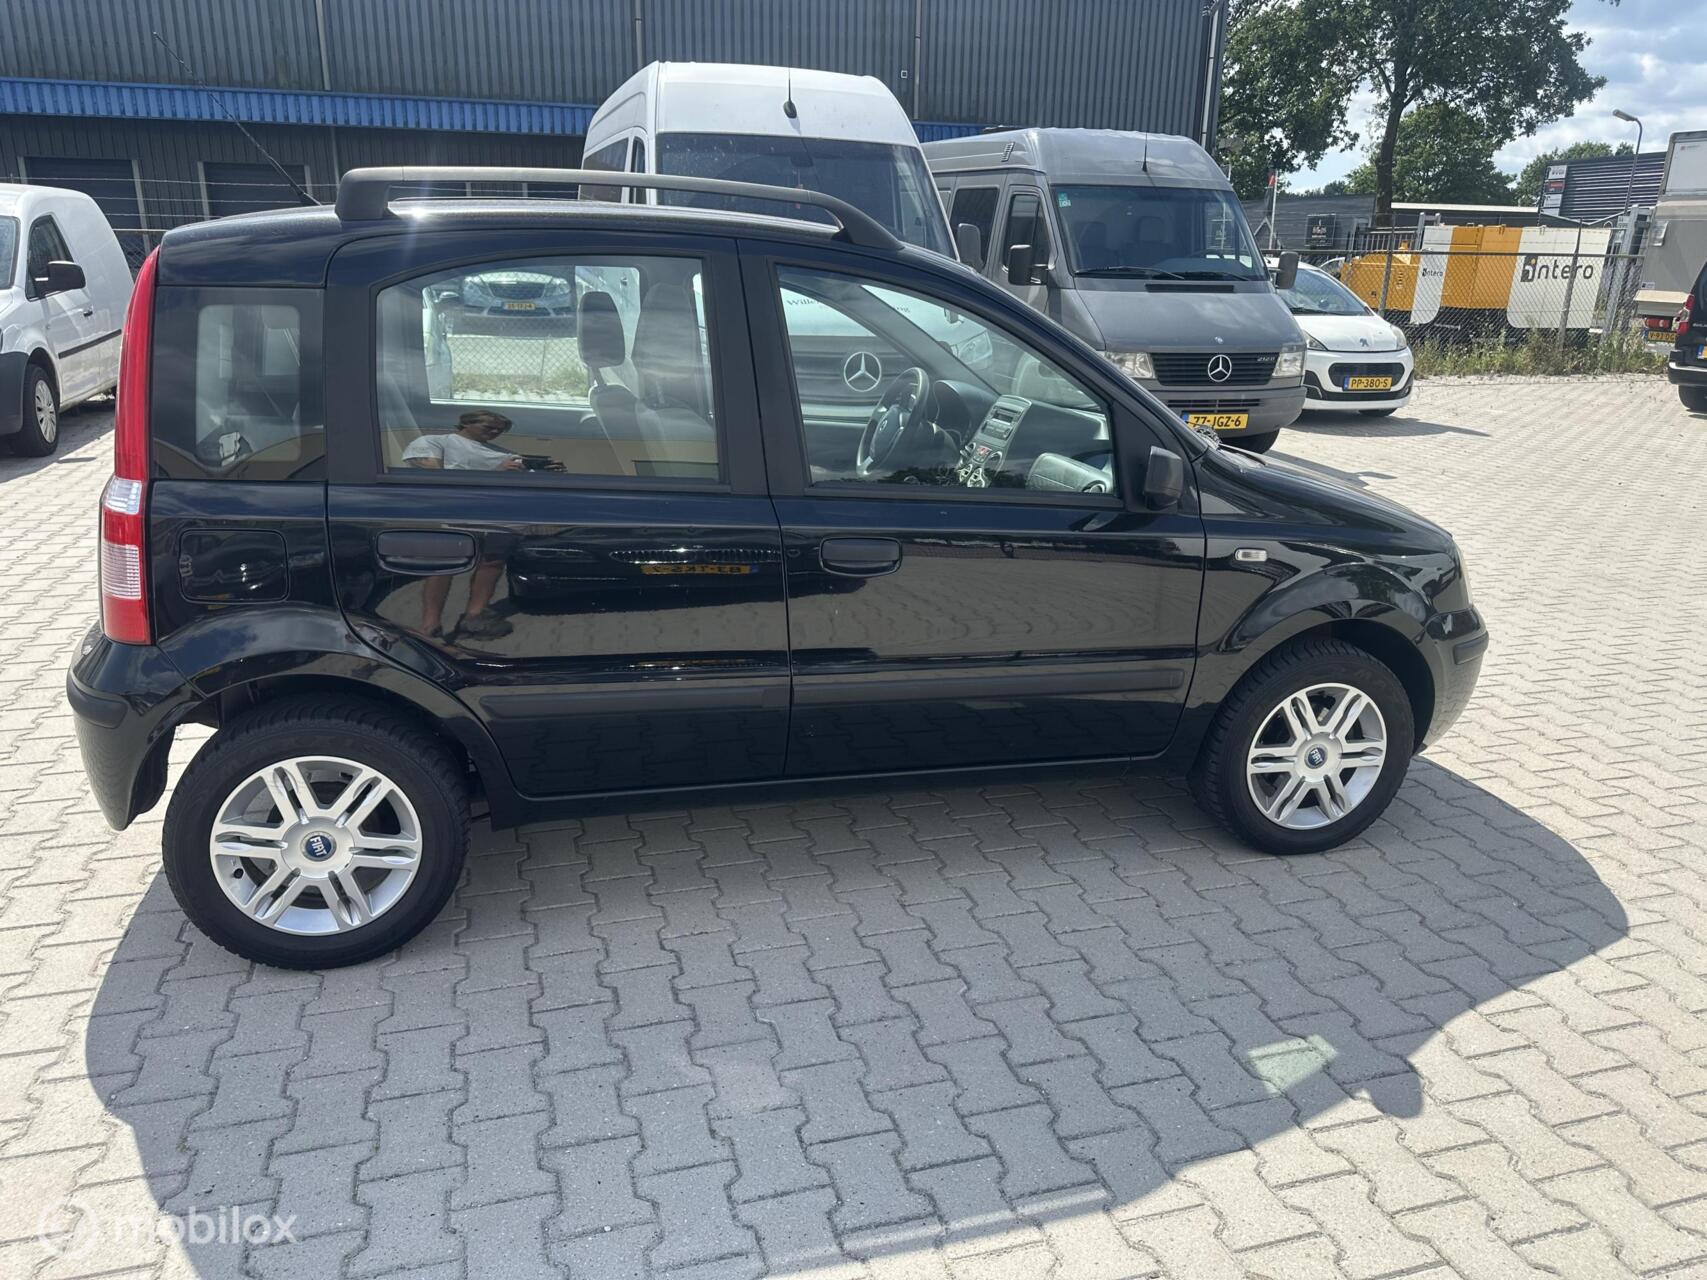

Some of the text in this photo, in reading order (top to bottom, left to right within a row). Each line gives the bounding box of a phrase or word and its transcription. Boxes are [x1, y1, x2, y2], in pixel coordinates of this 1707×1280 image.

[1350, 376, 1389, 389] PP-380-S
[1193, 415, 1242, 428] 77-JGZ-6
[1310, 748, 1323, 765] FIAT
[310, 836, 328, 856] FIAT
